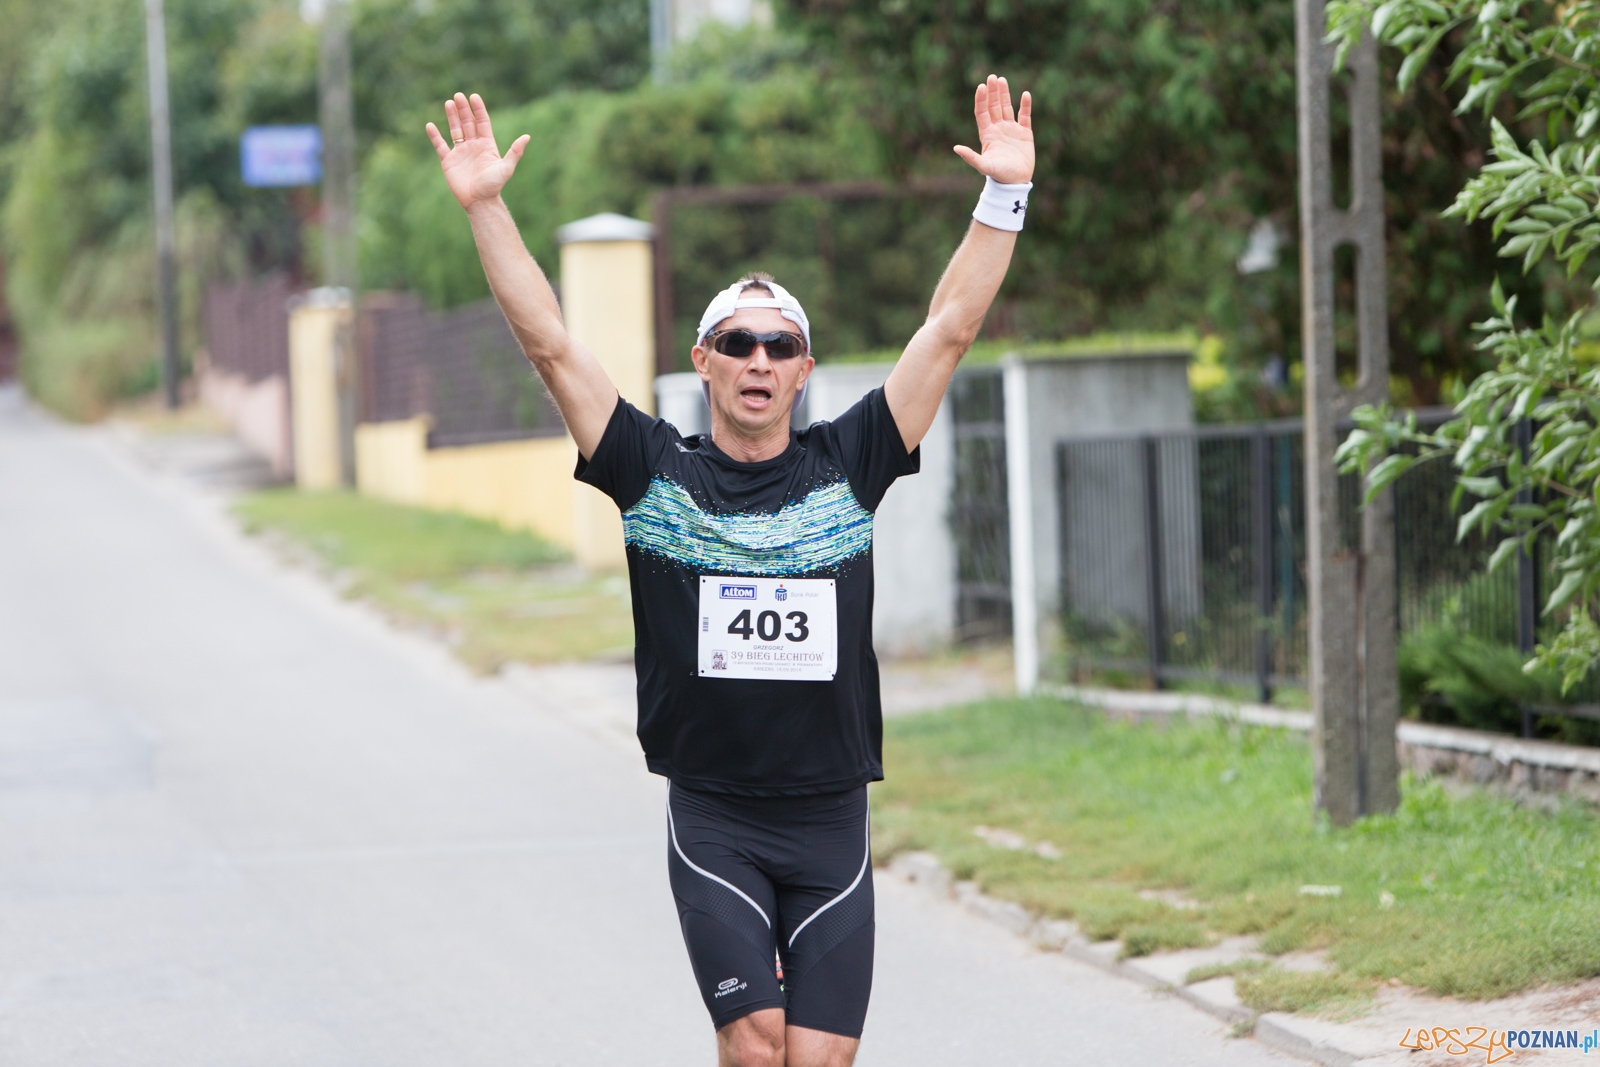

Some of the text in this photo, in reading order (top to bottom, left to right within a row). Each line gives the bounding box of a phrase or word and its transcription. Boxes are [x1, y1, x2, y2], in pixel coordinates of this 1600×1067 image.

[727, 609, 810, 643] 403
[731, 651, 825, 662] 39 BIEG LECHITÓW
[714, 981, 747, 998] Kalenji
